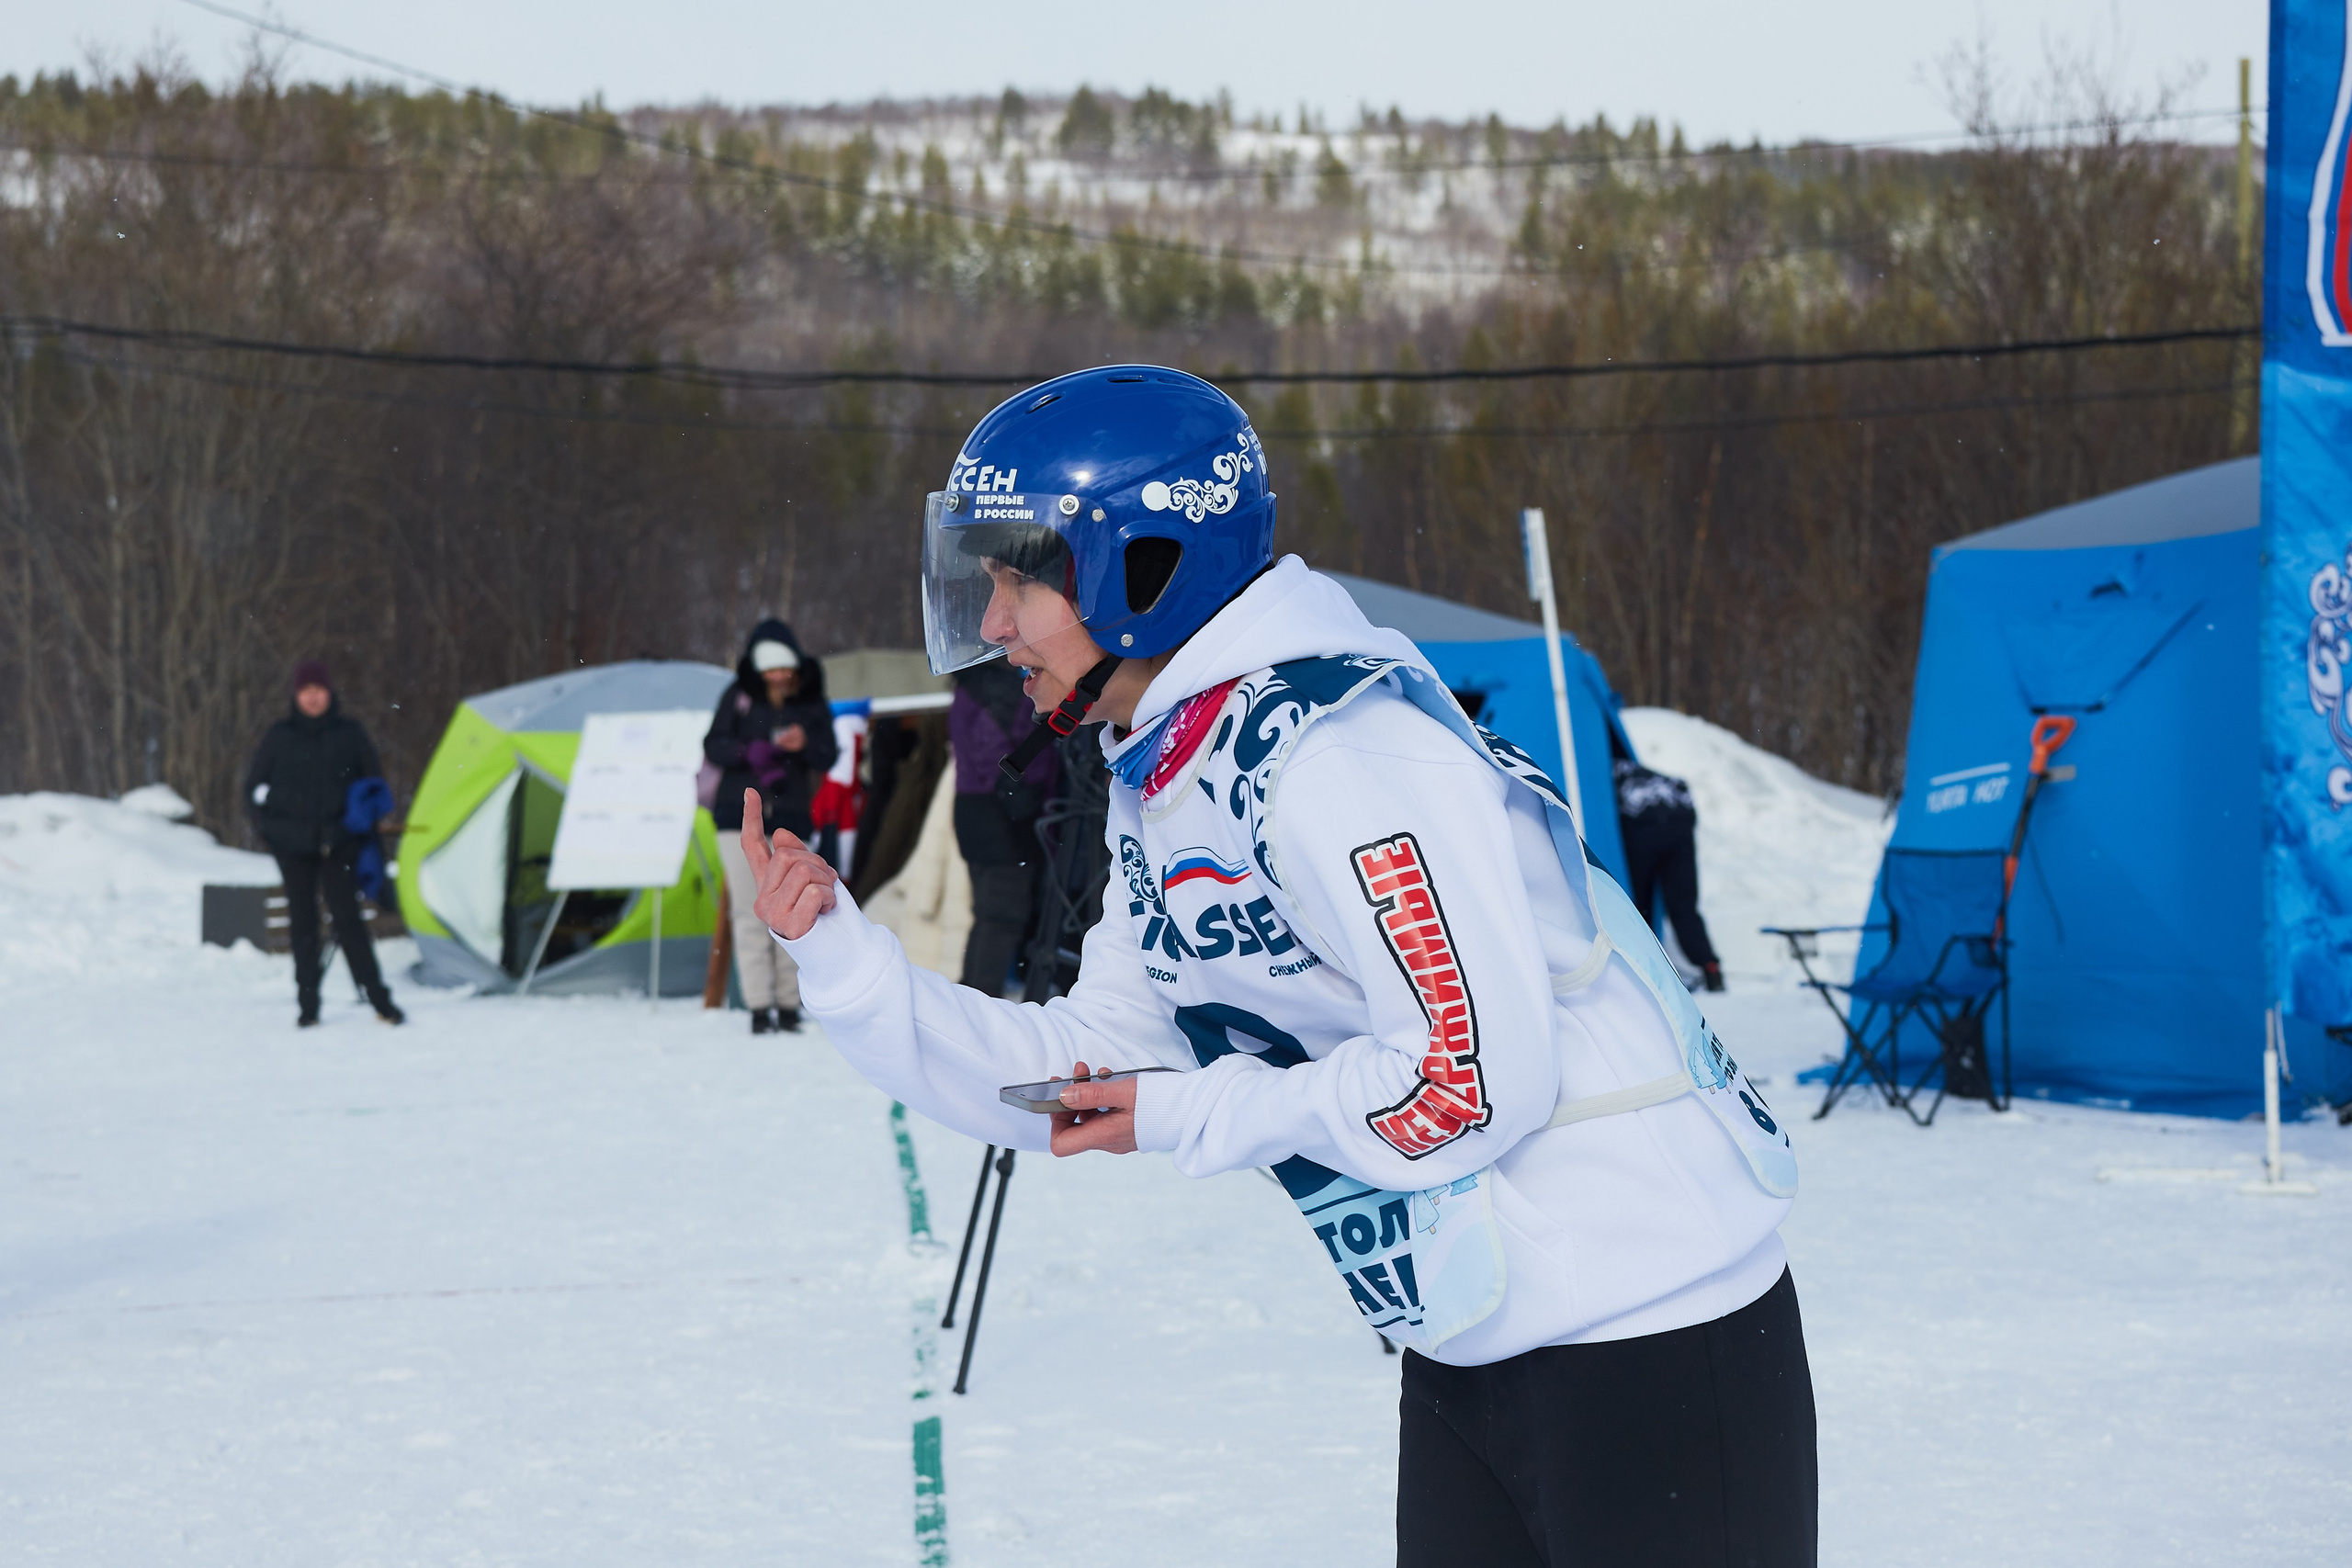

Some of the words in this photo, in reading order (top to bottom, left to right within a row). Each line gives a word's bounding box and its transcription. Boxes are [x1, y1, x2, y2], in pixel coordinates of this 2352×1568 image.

[975, 494, 1025, 506] ПЕРВЫЕ
[974, 508, 982, 519] В
[983, 508, 1035, 521] РОССИИ
